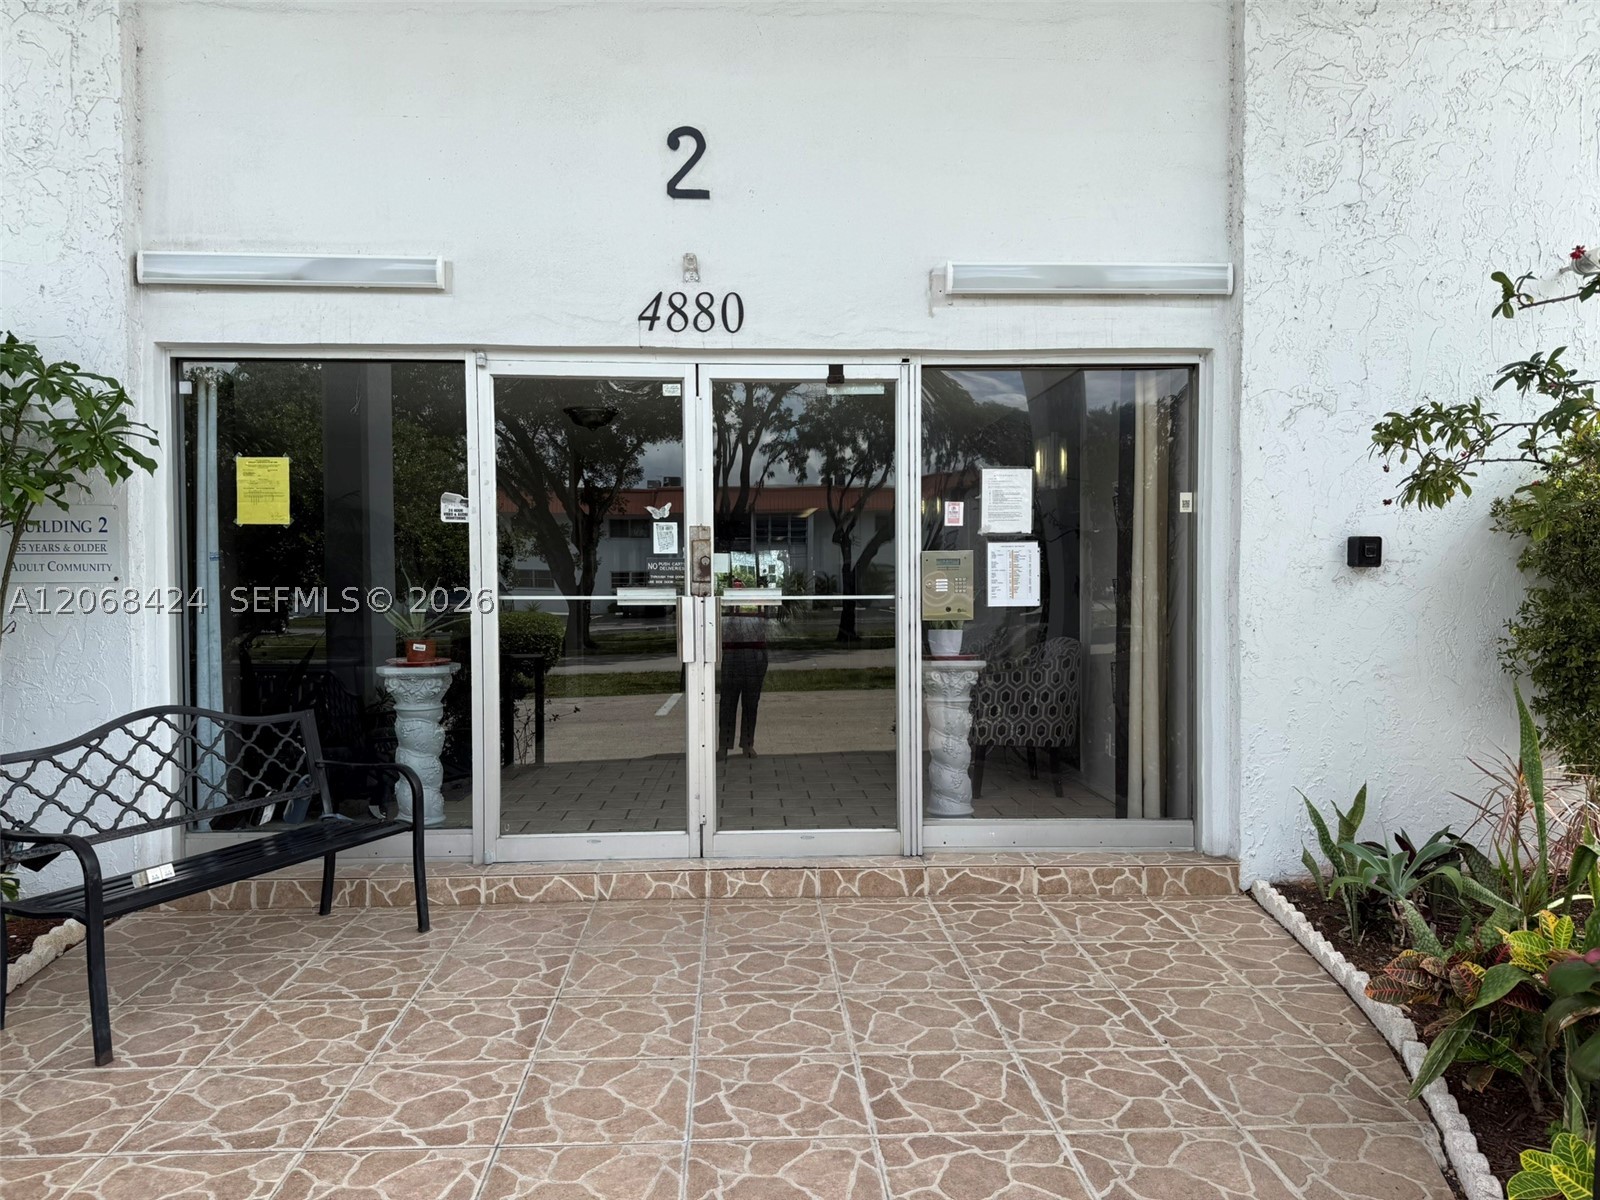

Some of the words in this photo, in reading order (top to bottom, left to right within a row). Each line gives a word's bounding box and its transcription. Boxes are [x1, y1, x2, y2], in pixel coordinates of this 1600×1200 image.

[666, 126, 710, 200] 2
[638, 291, 744, 334] 4880
[12, 520, 93, 533] UILDING
[98, 516, 108, 533] 2
[29, 543, 61, 552] YEARS
[63, 544, 71, 552] &
[73, 543, 107, 552] OLDER
[47, 560, 113, 572] COMMUNITY
[647, 562, 658, 570] NO
